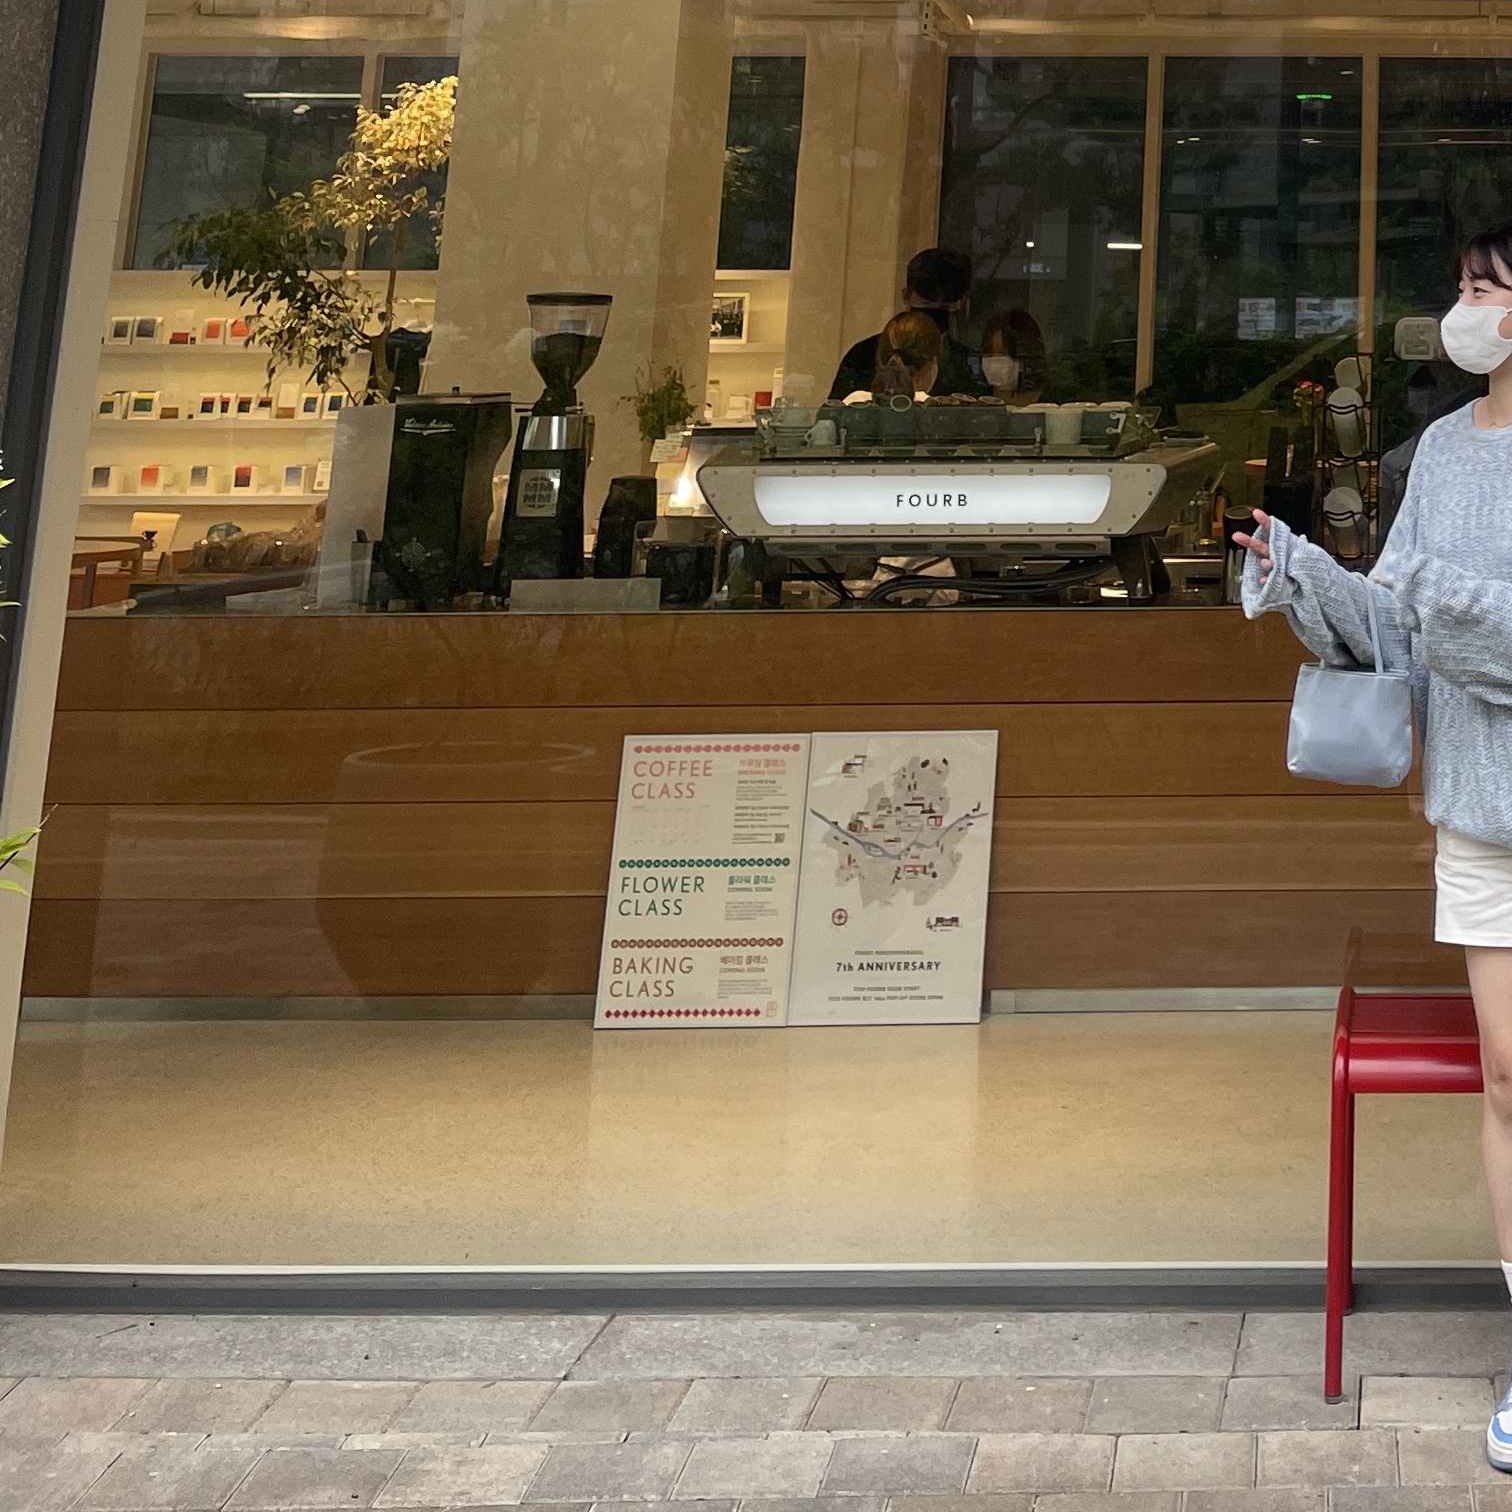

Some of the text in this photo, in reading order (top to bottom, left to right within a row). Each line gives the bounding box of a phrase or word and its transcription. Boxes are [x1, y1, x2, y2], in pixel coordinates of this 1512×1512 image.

[896, 493, 968, 507] FOURB
[633, 760, 713, 778] COFFEE
[631, 782, 696, 800] CLASS
[621, 876, 704, 894] FLOWER
[618, 899, 683, 916] CLASS
[612, 956, 694, 975] BAKING
[857, 961, 942, 972] ANNIVERSARY
[609, 979, 675, 998] CLASS
